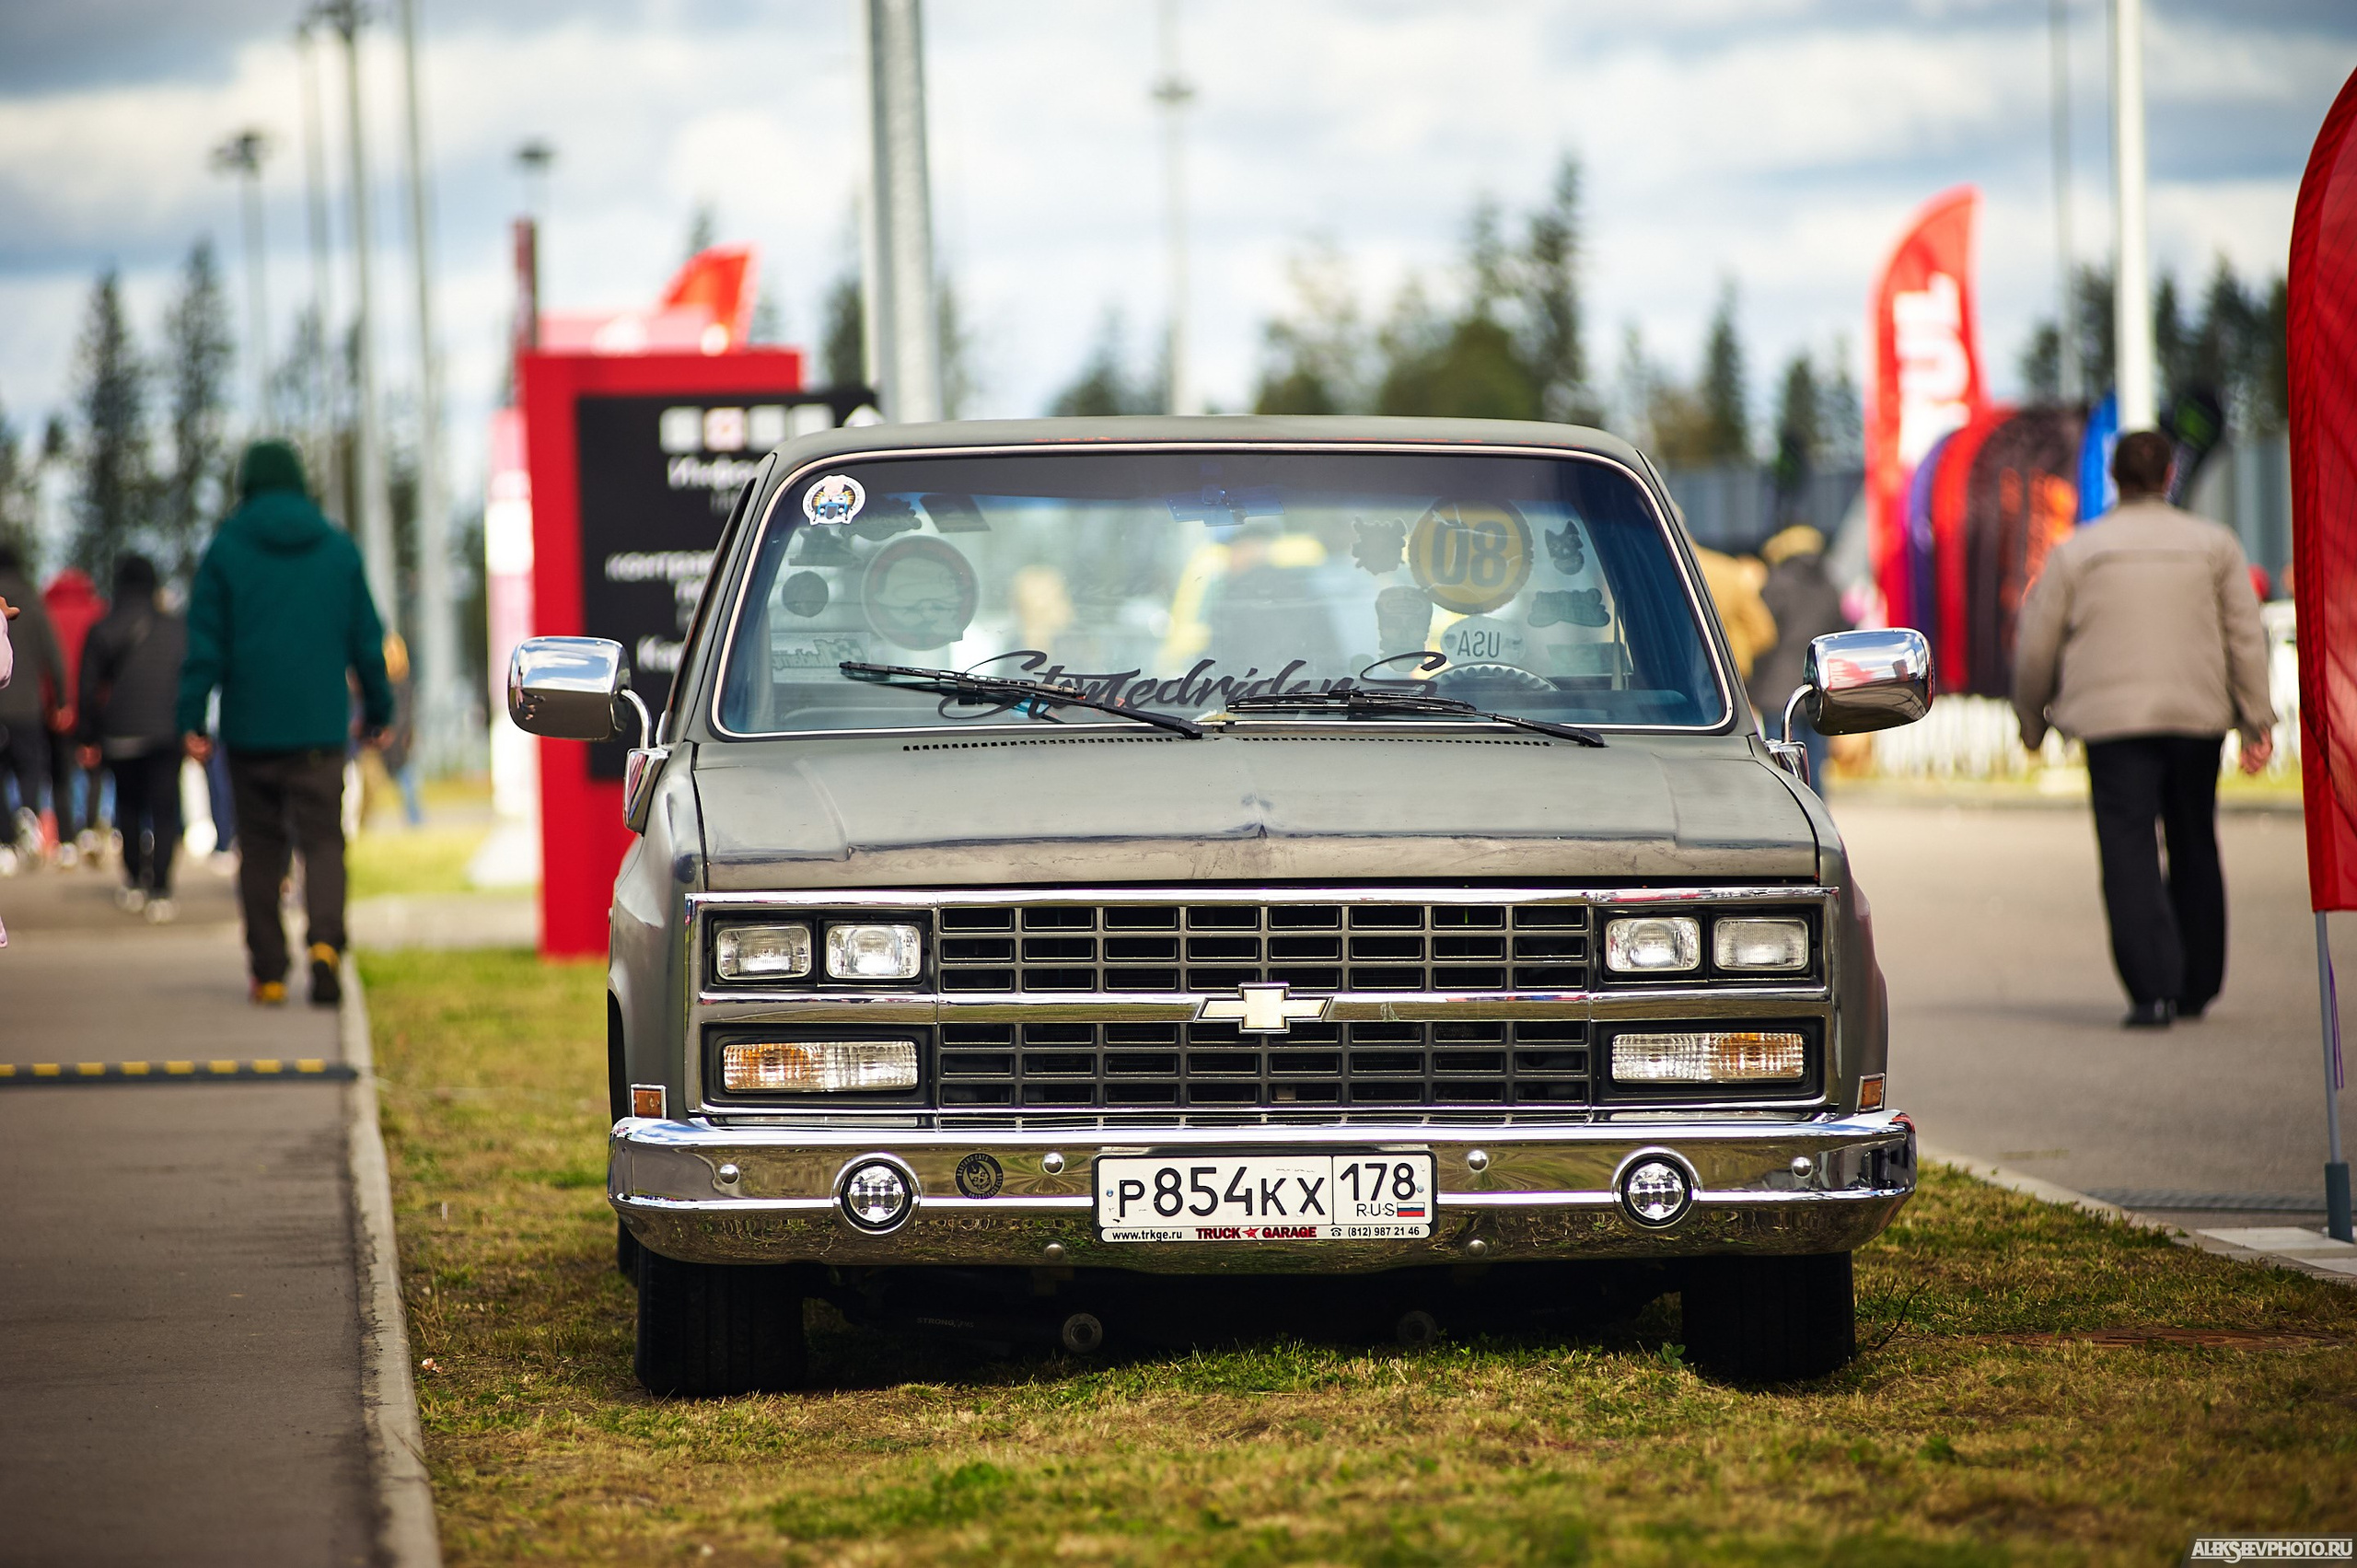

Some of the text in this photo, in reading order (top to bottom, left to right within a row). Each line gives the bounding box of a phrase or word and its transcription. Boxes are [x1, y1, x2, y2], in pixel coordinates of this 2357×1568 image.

[1340, 1162, 1415, 1202] 178
[1356, 1203, 1395, 1217] RUS
[1112, 1226, 1420, 1242] www.trkge.ru TRUCK GARAGE (812) 987 21 46
